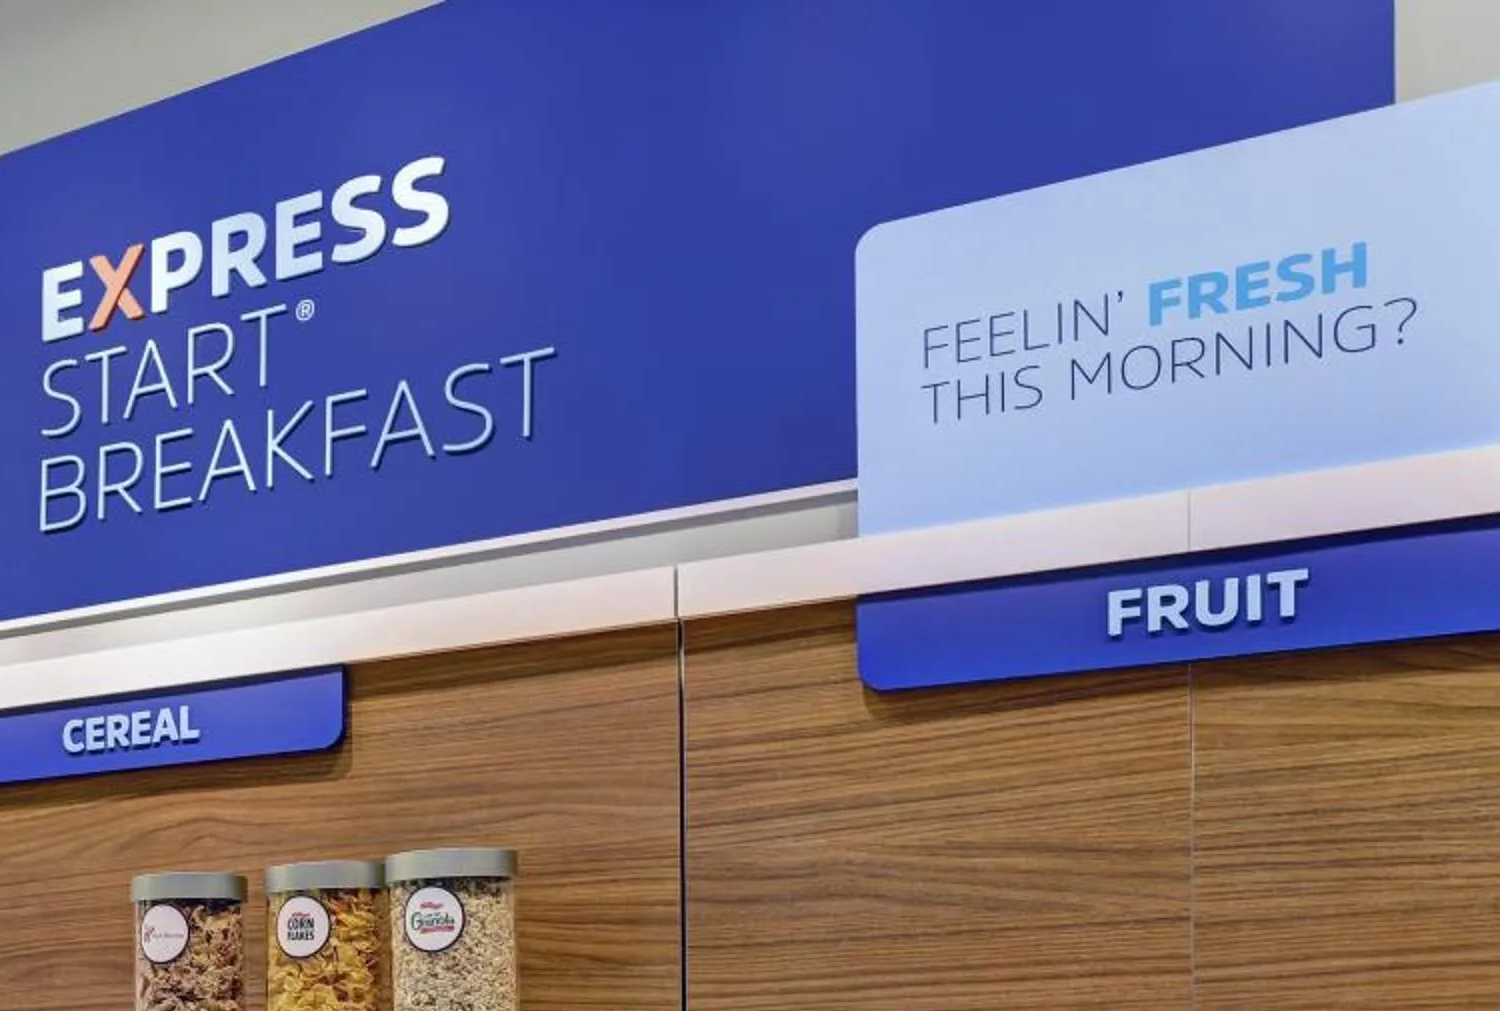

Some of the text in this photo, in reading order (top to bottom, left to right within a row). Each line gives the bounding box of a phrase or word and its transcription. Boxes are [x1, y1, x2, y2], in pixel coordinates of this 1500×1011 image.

[41, 156, 450, 342] EXPRESS
[922, 242, 1367, 369] FEELIN' FRESH
[921, 297, 1419, 424] THIS MORNING?
[39, 346, 557, 533] BREAKFAST
[1106, 568, 1310, 638] FRUIT
[61, 705, 201, 753] CEREAL
[287, 917, 315, 931] CORN
